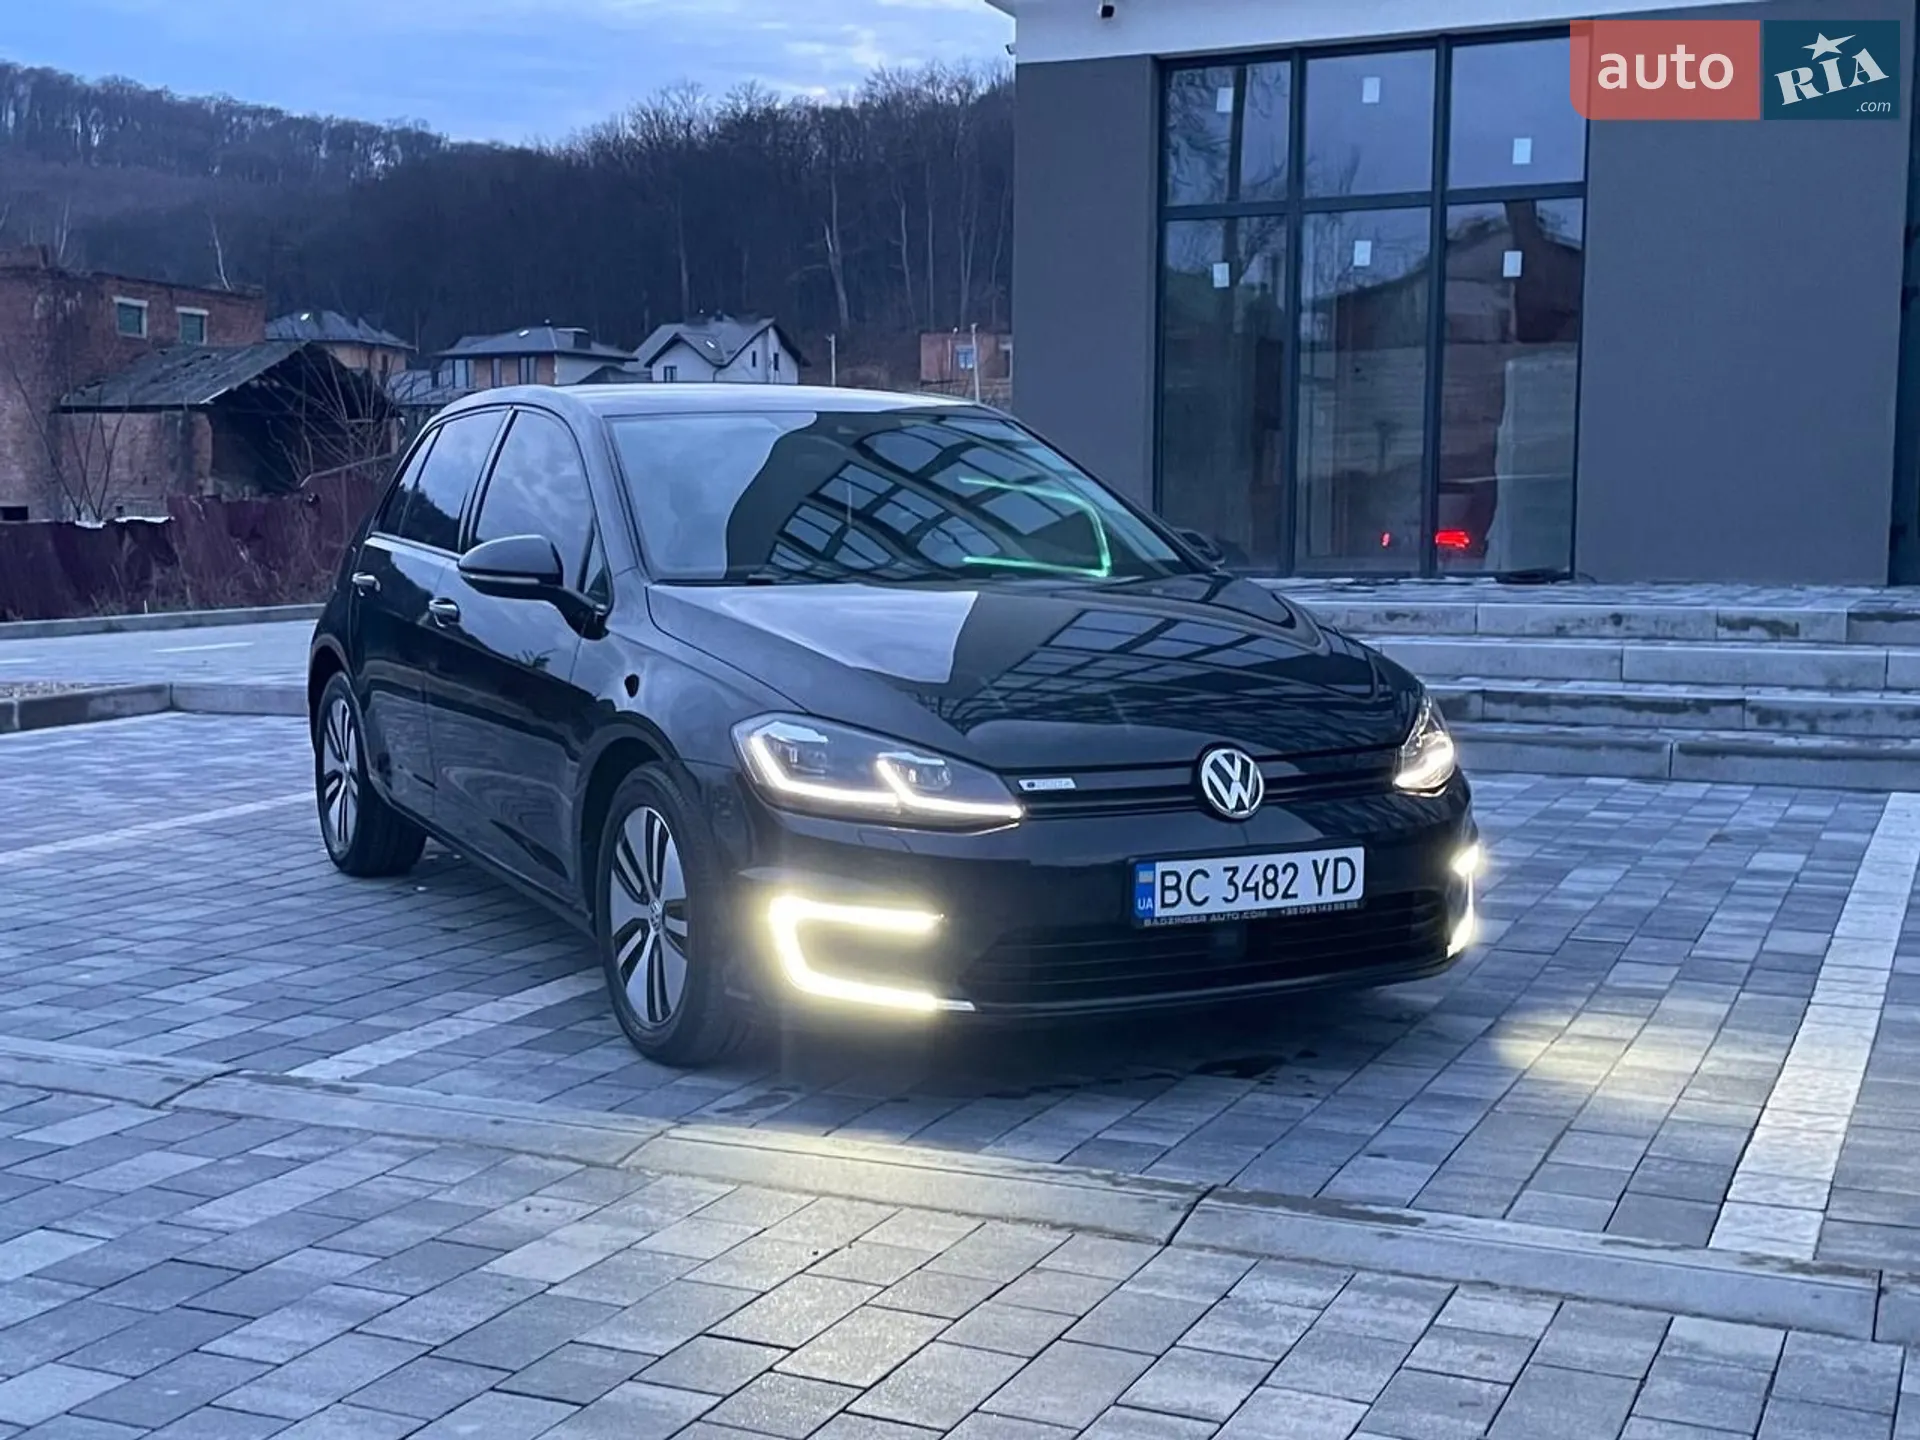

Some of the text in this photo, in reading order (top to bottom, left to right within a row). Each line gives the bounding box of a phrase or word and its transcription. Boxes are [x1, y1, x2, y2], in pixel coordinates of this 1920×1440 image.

[1160, 856, 1357, 909] BC 3482 YD
[1137, 897, 1154, 911] UA
